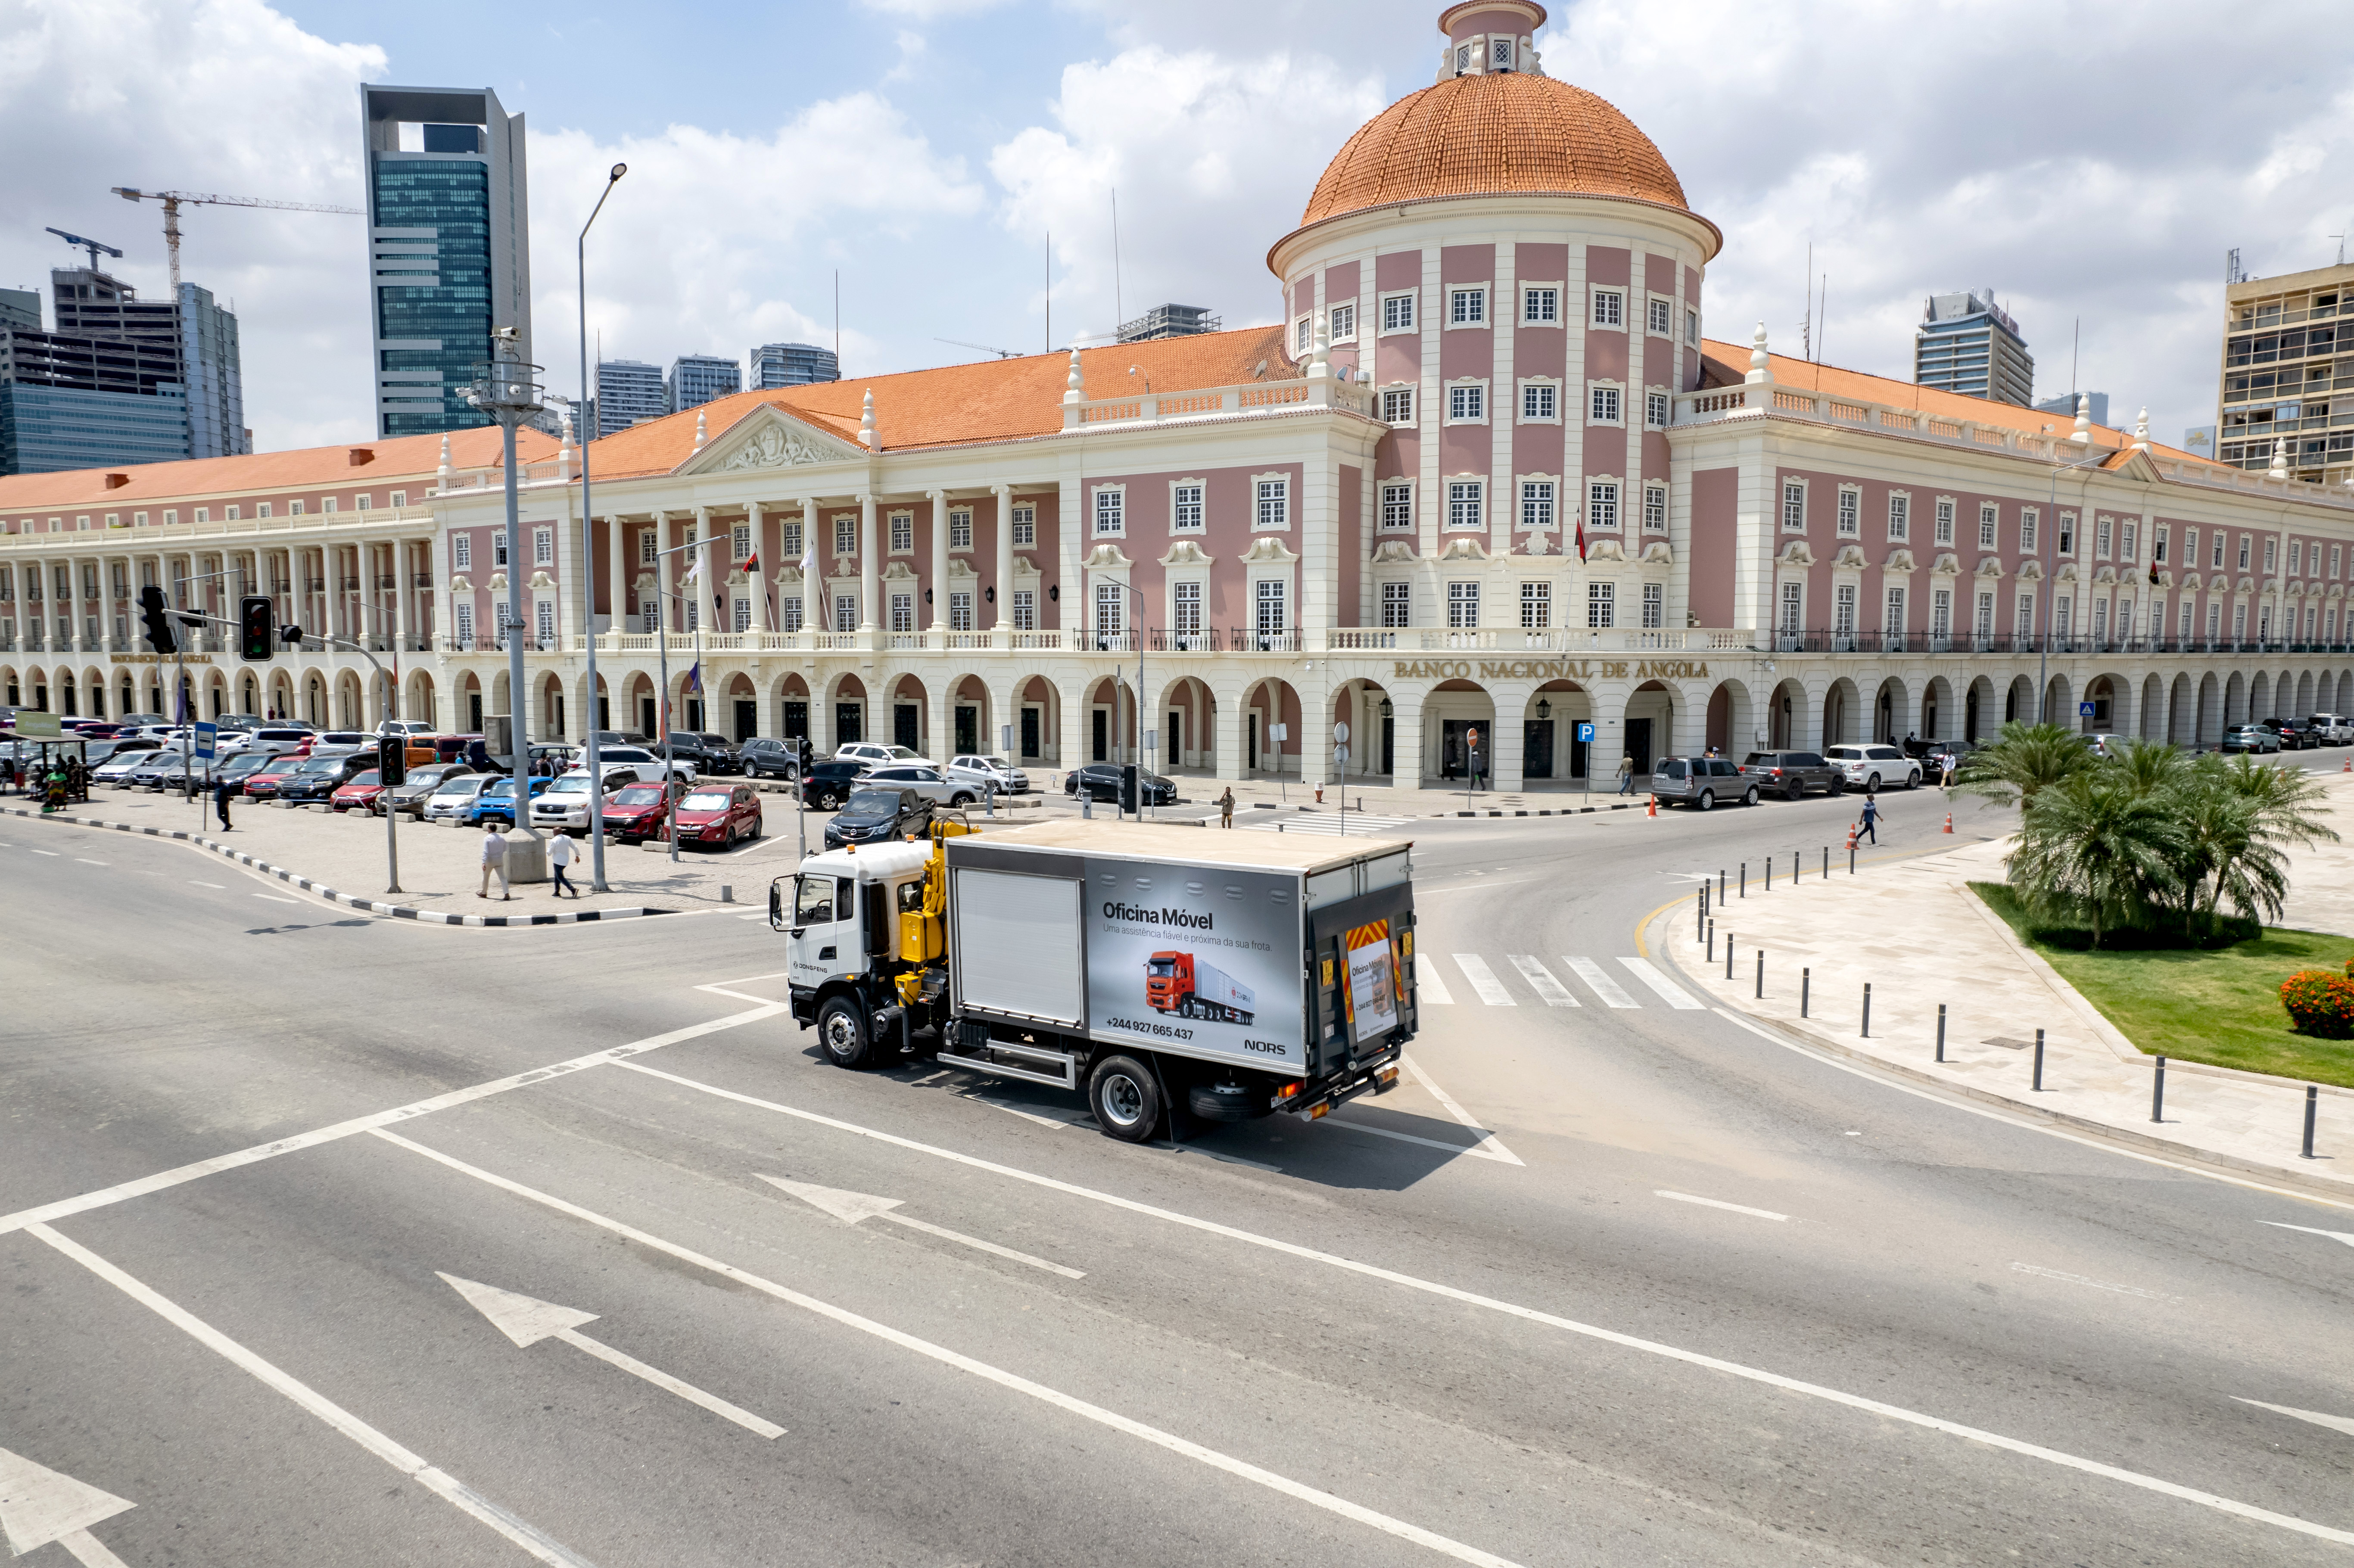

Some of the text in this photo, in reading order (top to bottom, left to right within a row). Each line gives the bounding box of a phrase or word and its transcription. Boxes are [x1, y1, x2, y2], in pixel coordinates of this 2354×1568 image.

[1394, 662, 1709, 678] BANCO NACIONAL DE ANGOLA
[1582, 726, 1592, 740] P
[1103, 902, 1213, 930] Oficina Móvel
[1103, 923, 1120, 933] Uma
[1121, 927, 1161, 938] assistência
[1163, 930, 1182, 941] fiável
[1191, 934, 1221, 945] próxima
[1223, 937, 1233, 947] da
[1235, 940, 1249, 949] sua
[1252, 940, 1272, 952] frota.
[799, 963, 827, 973] DONGFENG
[1352, 964, 1369, 977] Oficina
[1106, 1017, 1193, 1040] +244 927 665 437
[1244, 1039, 1286, 1055] NORS
